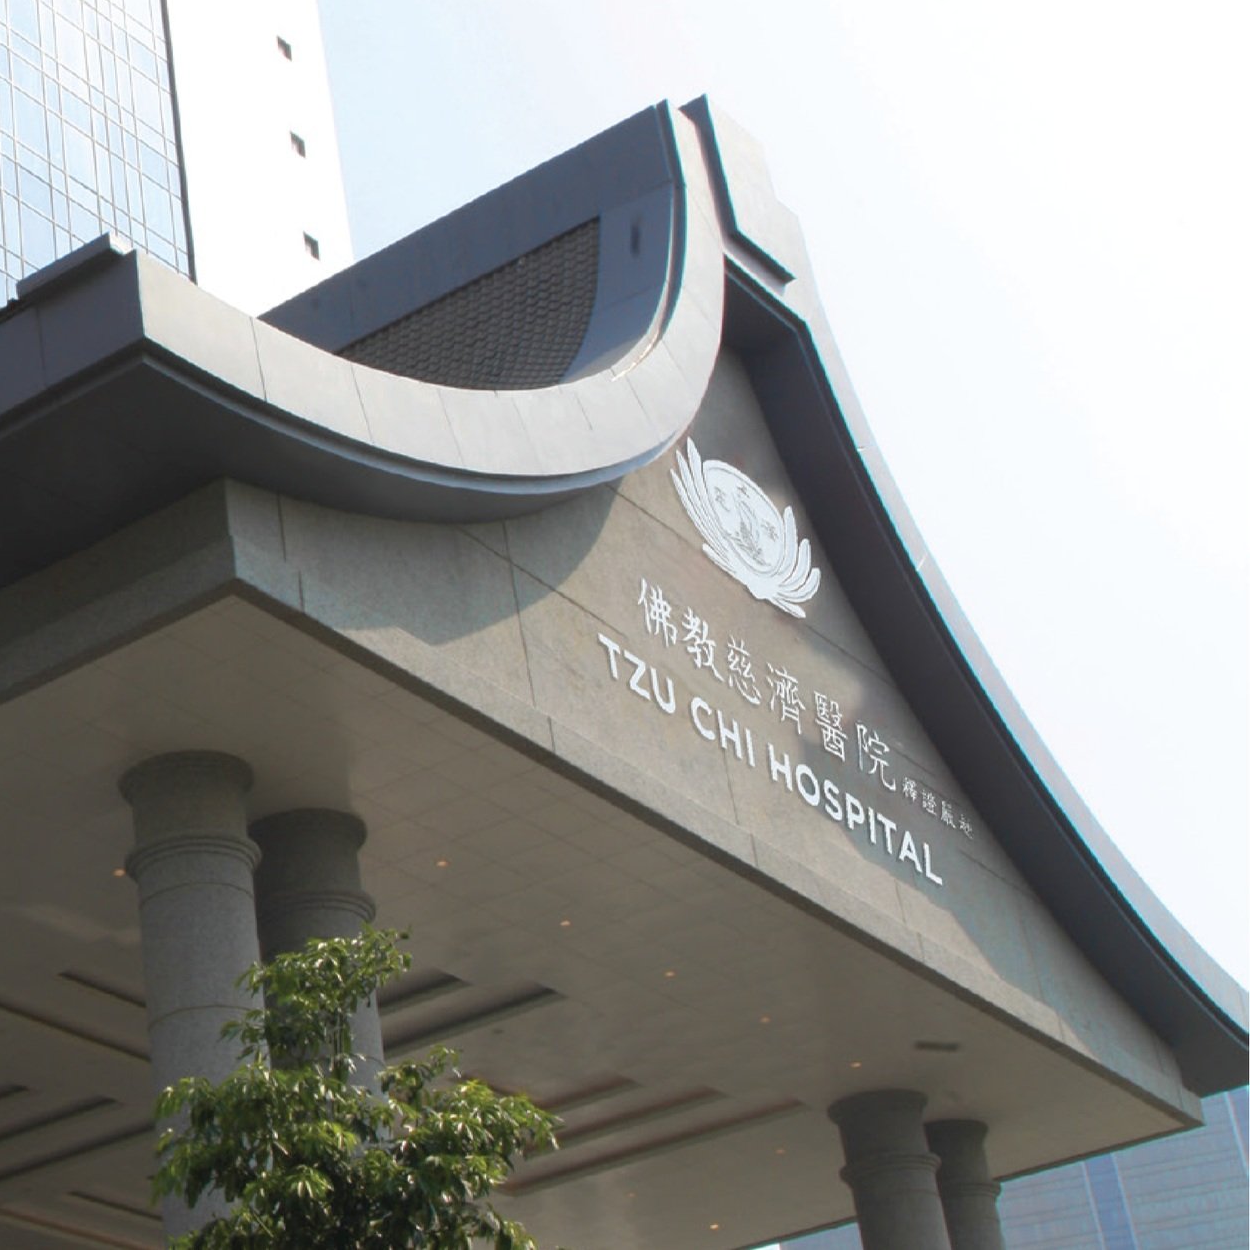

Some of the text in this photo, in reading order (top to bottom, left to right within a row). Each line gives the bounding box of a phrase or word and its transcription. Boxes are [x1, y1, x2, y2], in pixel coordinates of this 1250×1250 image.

[597, 632, 943, 886] TZU CHI HOSPITAL
[638, 577, 896, 791] 佛教慈濟醫院
